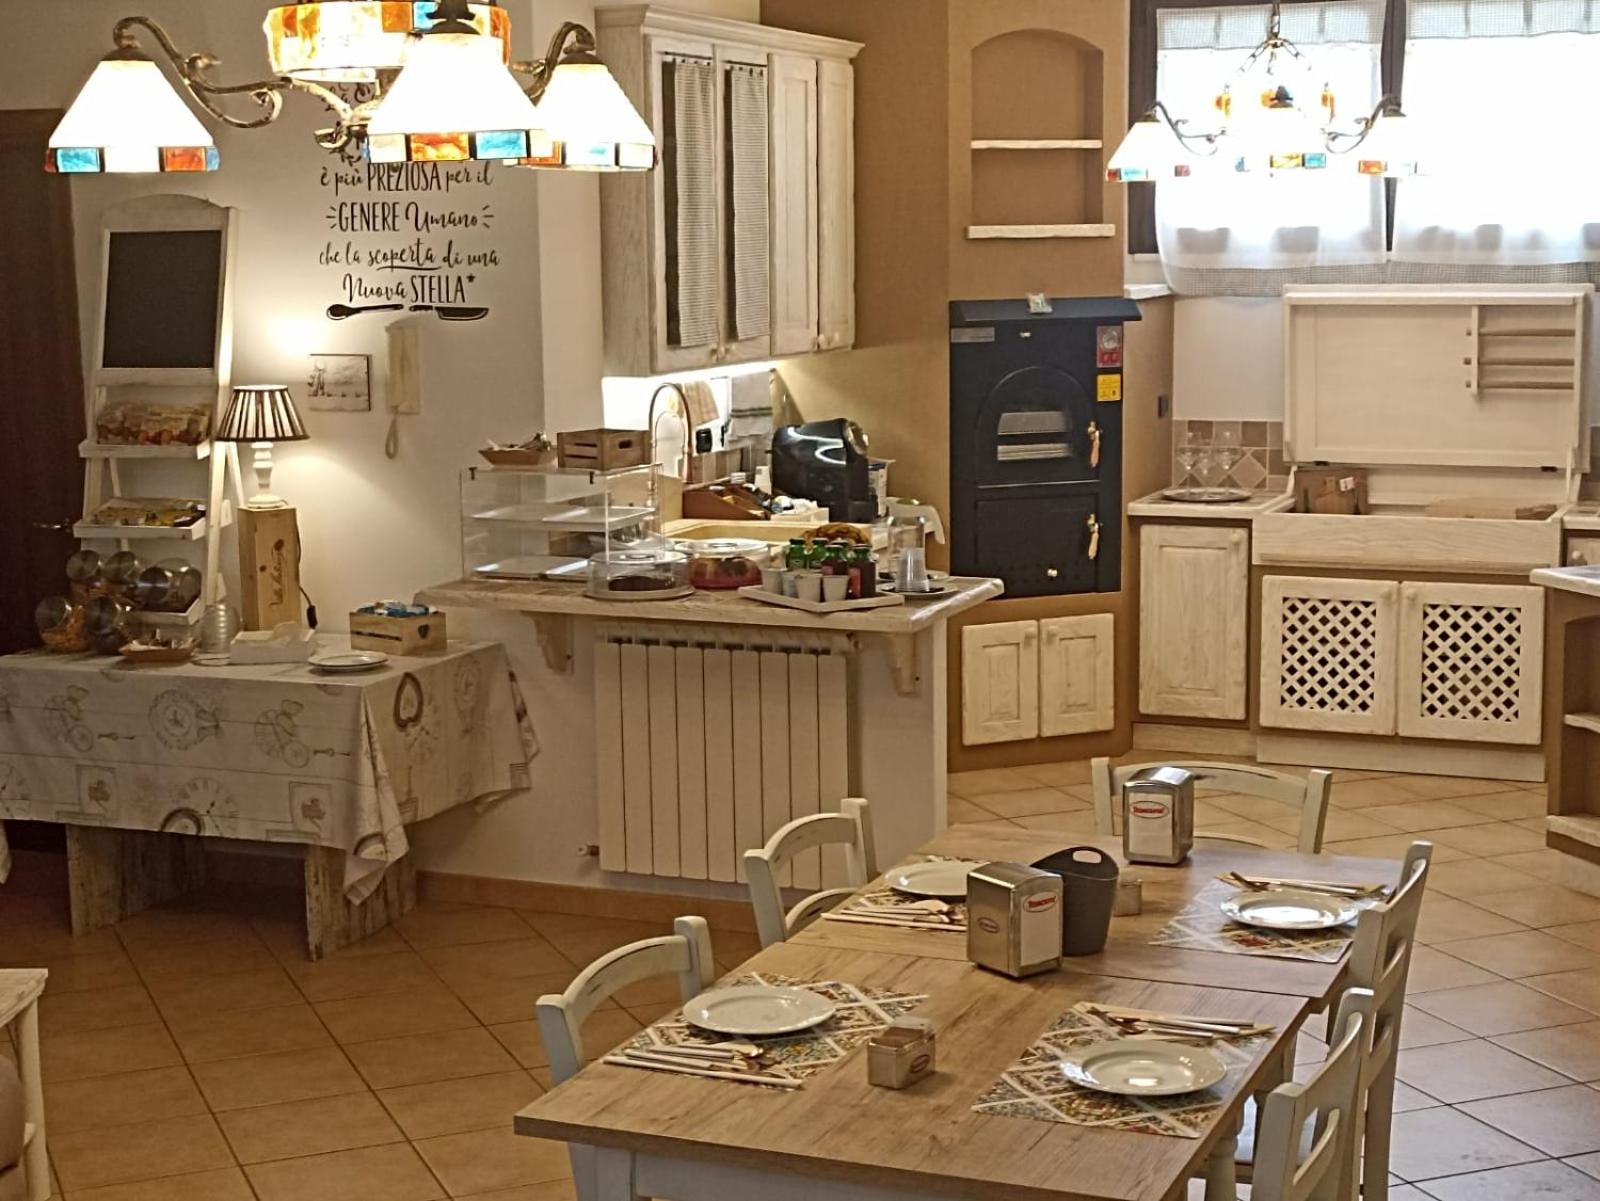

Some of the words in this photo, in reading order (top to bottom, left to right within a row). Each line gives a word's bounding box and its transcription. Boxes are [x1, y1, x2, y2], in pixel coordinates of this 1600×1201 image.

[320, 167, 330, 187] è
[336, 170, 362, 195] più
[368, 163, 441, 192] PREZIOSA
[446, 168, 473, 192] per
[477, 161, 493, 185] il
[338, 202, 400, 231] GENERE
[405, 201, 478, 233] Umano
[319, 242, 340, 265] che
[345, 243, 360, 264] la
[368, 238, 436, 271] scoperta
[442, 240, 462, 268] di
[467, 251, 500, 267] una
[342, 273, 407, 303] Nuova
[410, 275, 466, 303] STELLA
